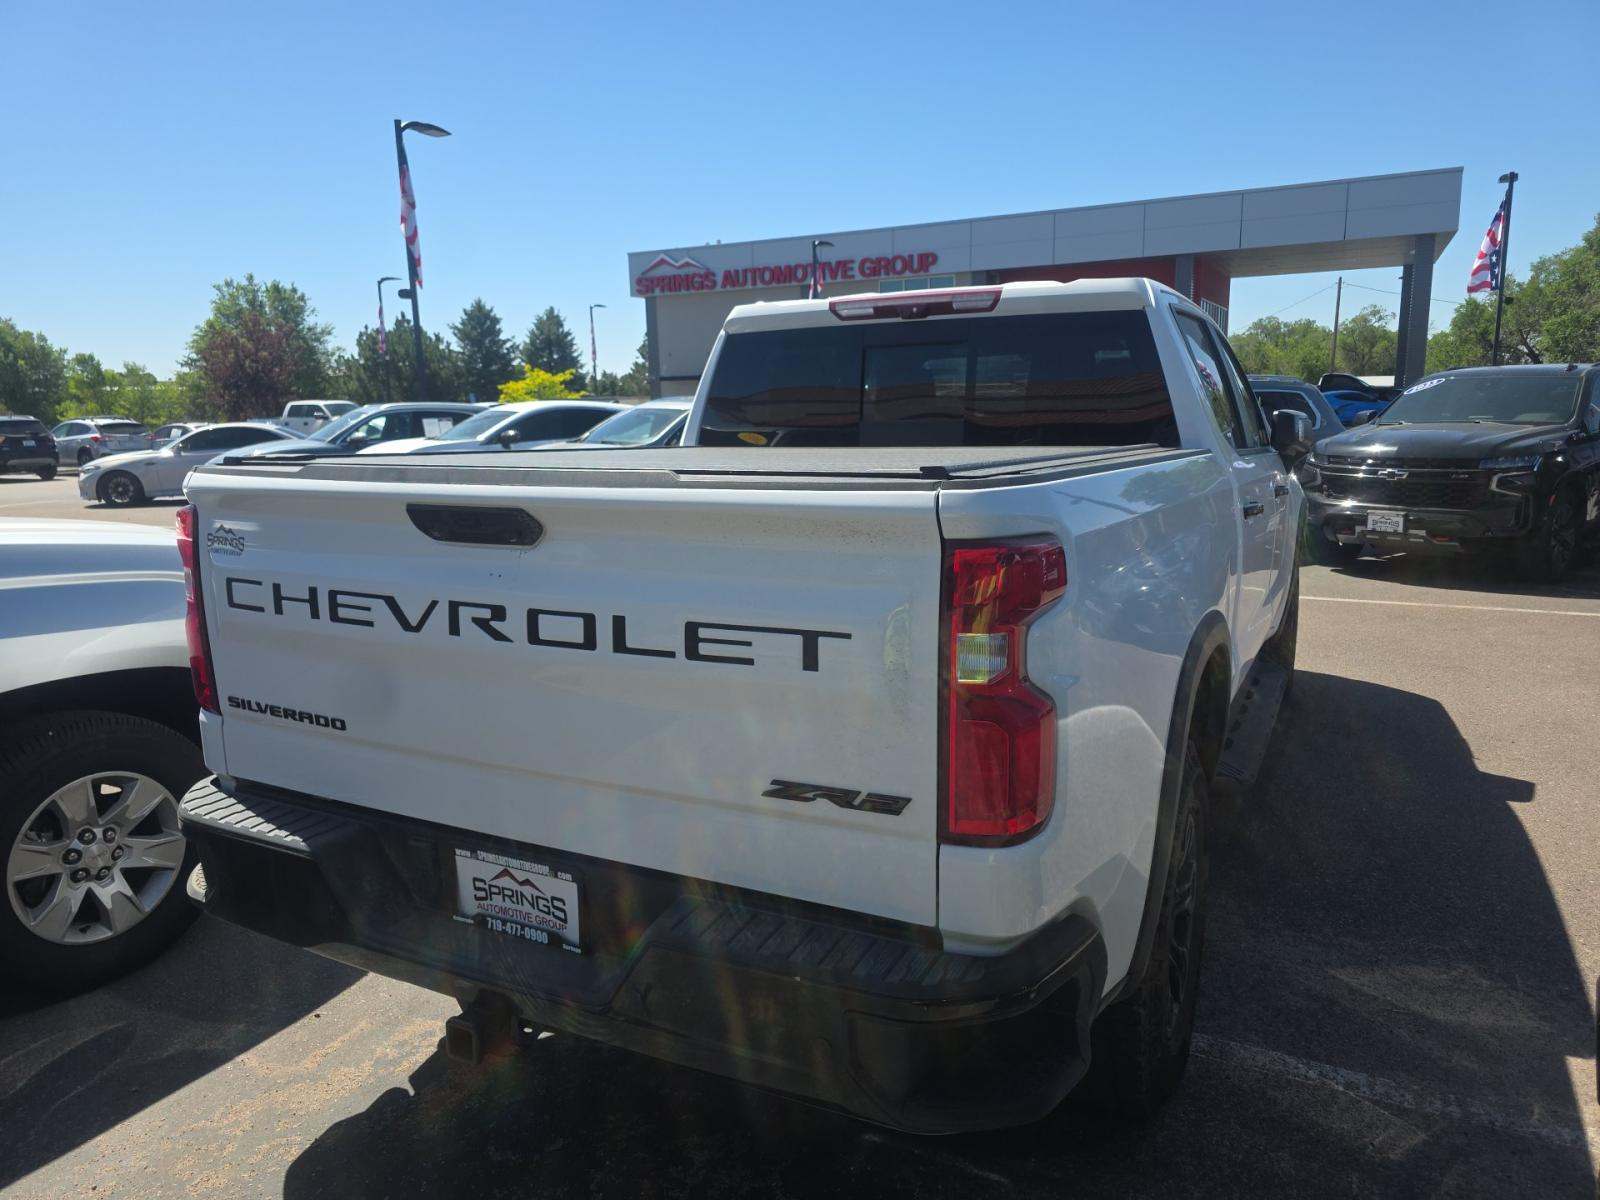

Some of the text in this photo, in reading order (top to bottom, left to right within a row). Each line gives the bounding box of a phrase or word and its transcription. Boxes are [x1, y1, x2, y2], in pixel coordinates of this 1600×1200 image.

[635, 270, 717, 295] SPRINGS
[857, 252, 938, 279] GROUP
[207, 532, 245, 552] SPRINGS
[226, 576, 852, 672] CHEVROLET
[227, 695, 348, 731] SILVERADO
[472, 877, 568, 925] SPRINGS
[477, 902, 534, 923] AUTOMOTIVE
